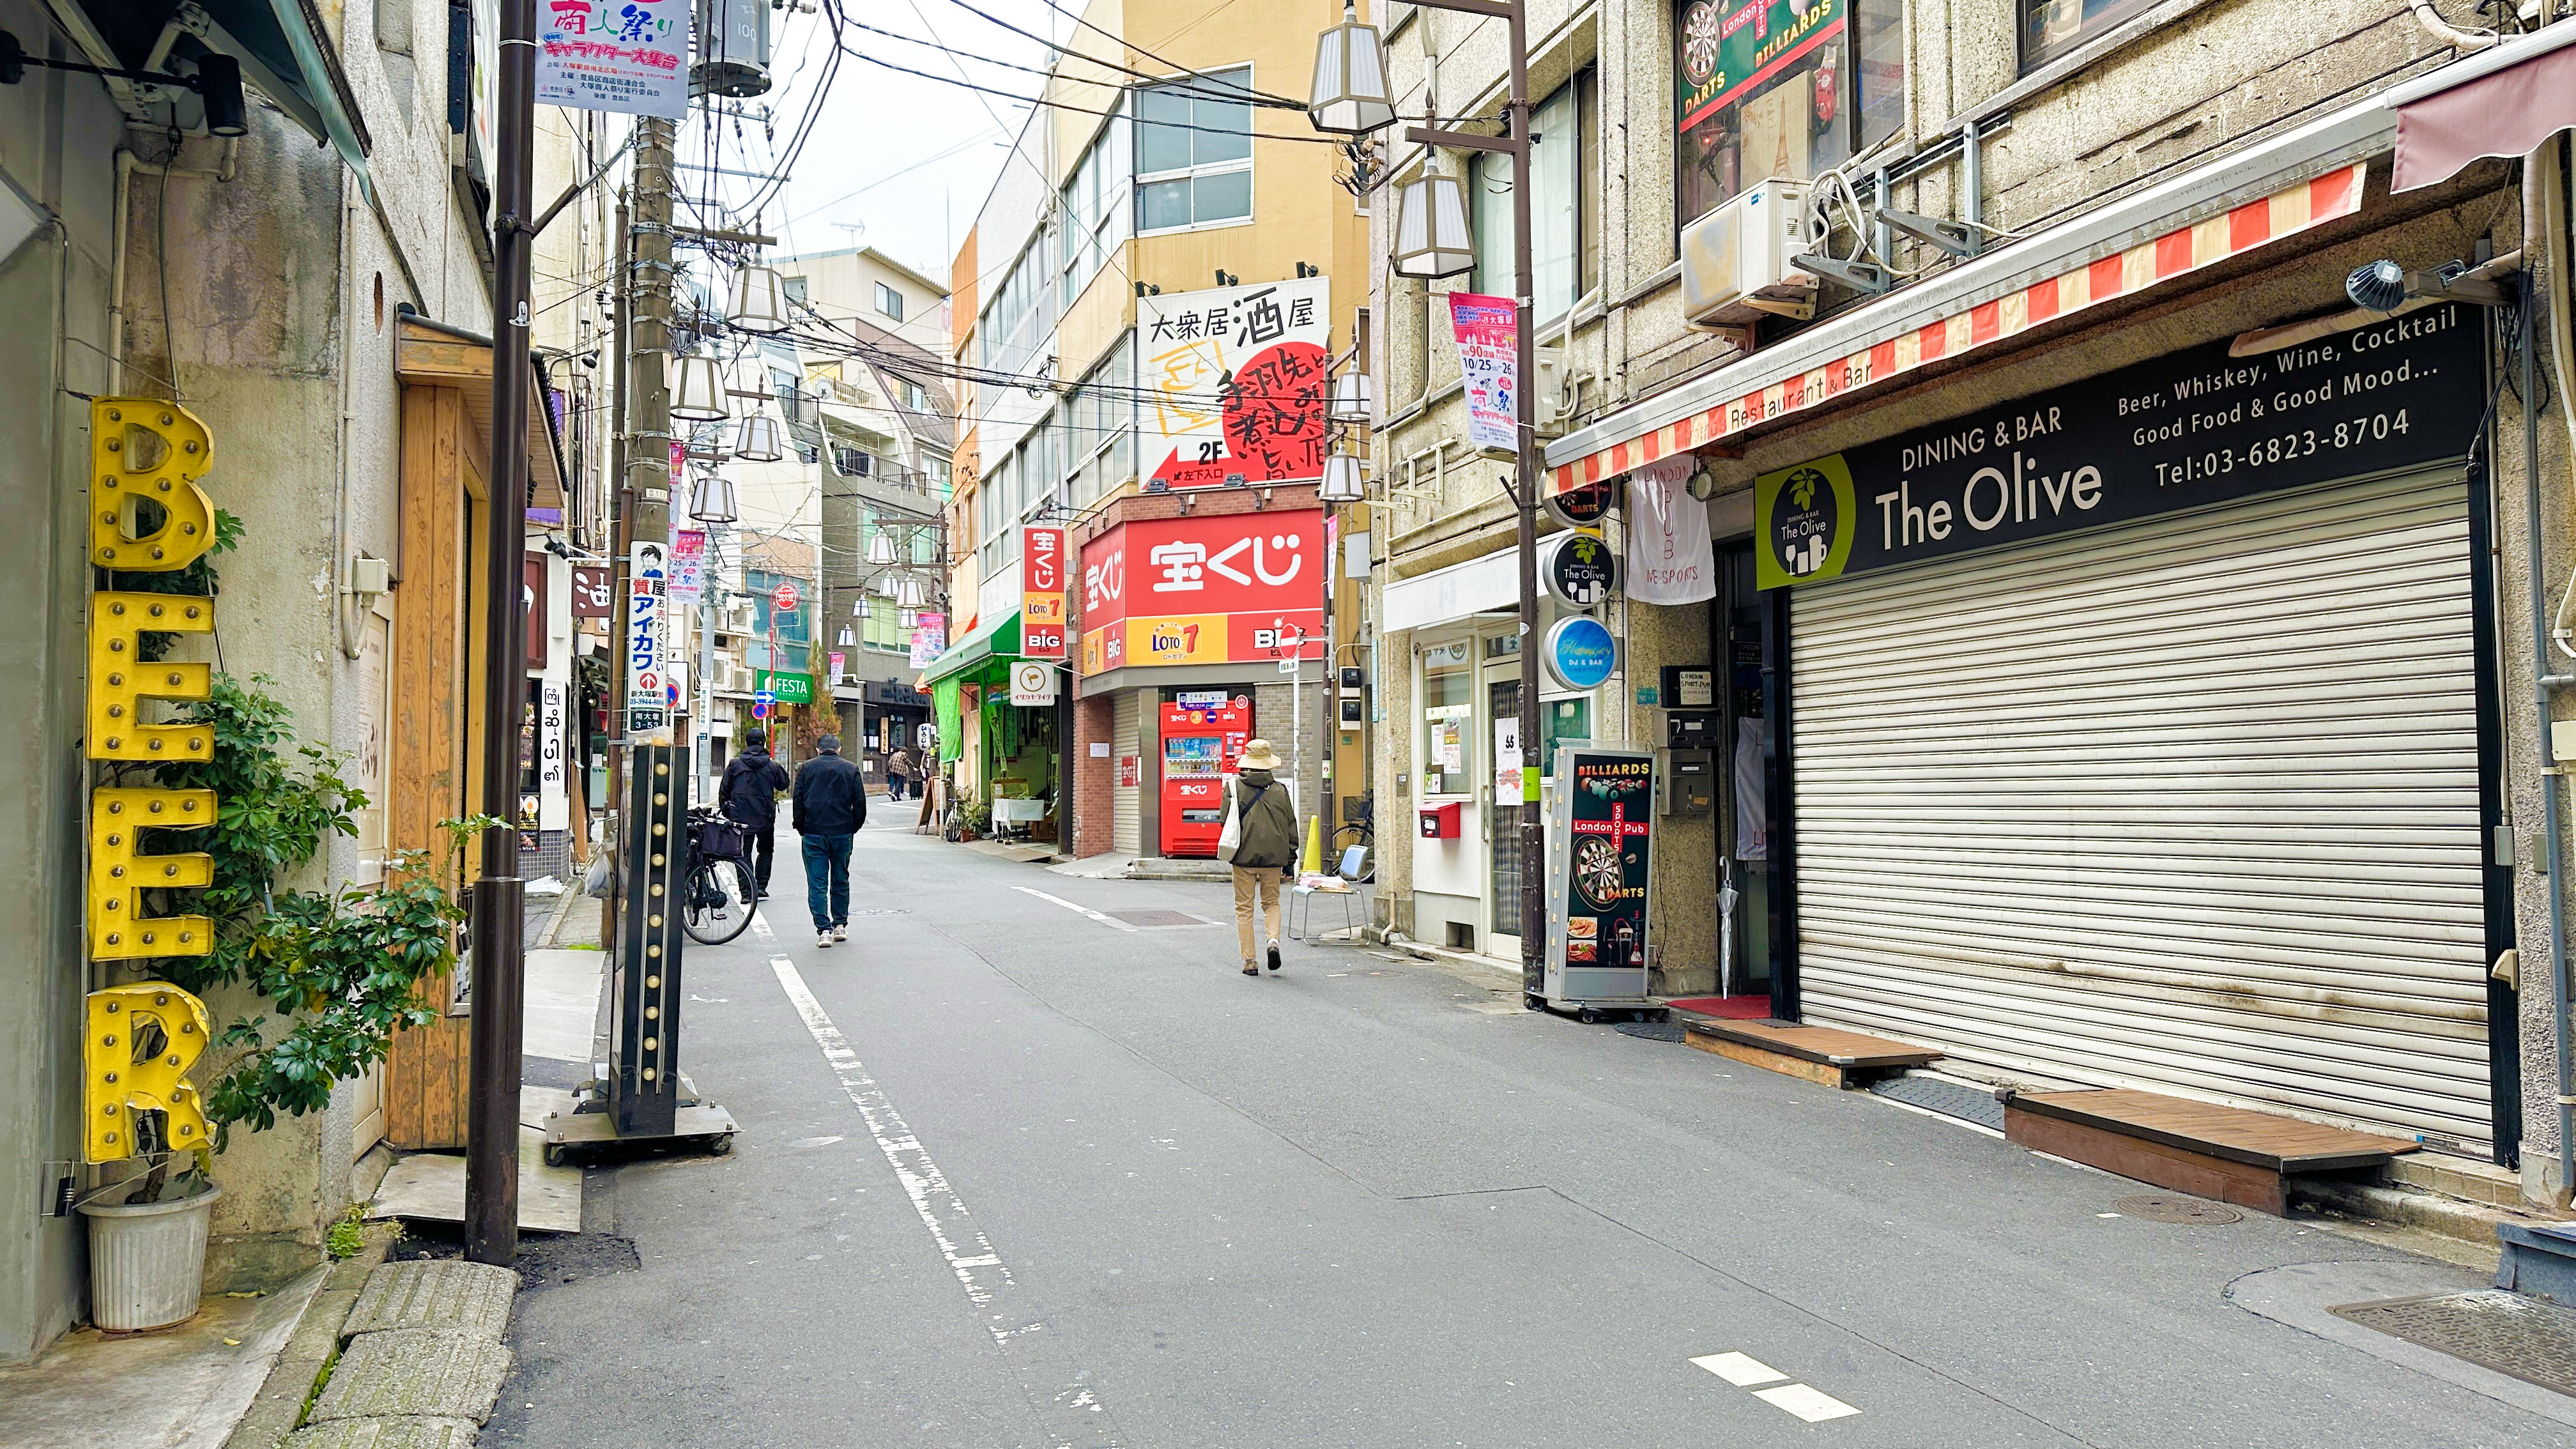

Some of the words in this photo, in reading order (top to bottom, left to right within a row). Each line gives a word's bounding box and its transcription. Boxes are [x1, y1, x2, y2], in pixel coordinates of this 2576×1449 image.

[738, 22, 756, 42] 100
[1724, 6, 1757, 35] London
[1755, 0, 1832, 68] BILLIARDS
[543, 40, 680, 71] キャラクター大集合
[1685, 72, 1725, 115] DARTS
[1151, 286, 1314, 346] 大衆居酒屋
[2119, 392, 2166, 417] Beer,
[2175, 363, 2267, 401] Whiskey,
[2277, 344, 2342, 373] Wine,
[2352, 305, 2457, 354] Cocktail
[1731, 379, 1823, 431] Restaurant
[1830, 379, 1837, 395] &
[1844, 362, 1873, 389] Bar
[2133, 418, 2183, 446] Good
[2191, 403, 2241, 433] Food
[2251, 398, 2264, 417] &
[2273, 380, 2332, 412] Good
[2343, 359, 2438, 396] Mood...
[1199, 441, 1222, 464] 2F
[1903, 428, 1985, 472] DINING
[1995, 421, 2010, 447] &
[2016, 406, 2062, 441] BAR
[2155, 408, 2409, 486] Tel:03-6823-8704
[1184, 468, 1223, 482] 左下入口
[1572, 503, 1598, 512] DARTS
[1875, 480, 1952, 550] The
[1964, 450, 2103, 531] Olive
[1781, 524, 1798, 540] The
[1800, 518, 1826, 535] Olive
[1787, 514, 1804, 523] DINING
[1033, 532, 1055, 588] 宝くじ
[1151, 533, 1302, 592] 宝くじ
[1564, 568, 1579, 578] The
[1581, 569, 1605, 579] Olive
[1662, 566, 1698, 583] SPORTS
[633, 579, 666, 597] 質屋
[1086, 549, 1122, 613] 宝くじ
[1029, 603, 1047, 614] LOTO
[1050, 599, 1060, 617] 7
[633, 596, 654, 670] アイカワ
[656, 599, 664, 671] お売りください
[1153, 634, 1180, 652] LOTO
[1183, 624, 1199, 653] 7
[776, 678, 808, 694] FESTA
[84, 395, 218, 1165] BEER
[1578, 763, 1650, 776] BILLIARDS
[1181, 785, 1207, 795] 宝くじ
[1575, 821, 1613, 832] London
[1625, 824, 1644, 834] Pub
[1607, 887, 1644, 900] DARTS
